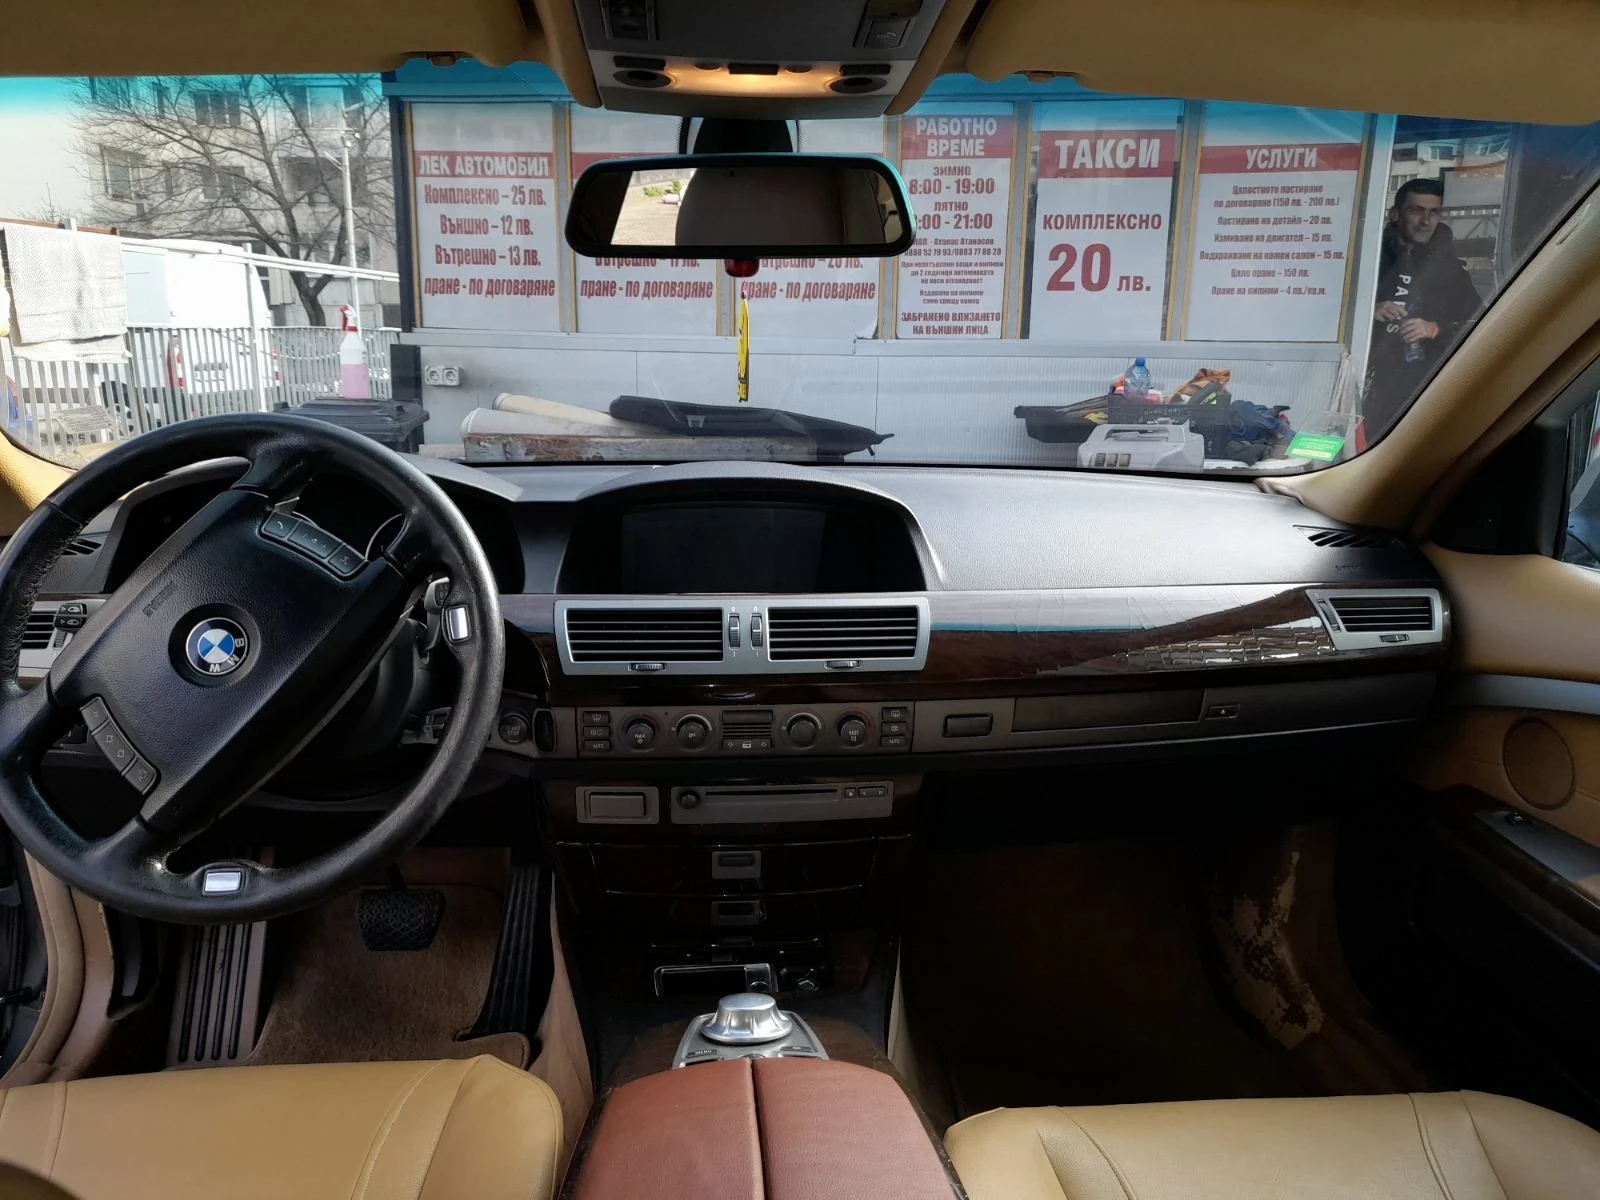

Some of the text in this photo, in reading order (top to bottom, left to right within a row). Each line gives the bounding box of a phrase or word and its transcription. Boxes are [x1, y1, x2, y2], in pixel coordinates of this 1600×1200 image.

[915, 117, 997, 136] РАБОТНО
[926, 138, 985, 157] ВРЕМЕ
[1054, 138, 1161, 170] ТАКСИ
[419, 155, 549, 177] ЛЕК АВТОМОБИЛ
[1245, 147, 1318, 170] УСЛУГИ
[933, 165, 971, 177] ЗИМНО
[424, 184, 499, 206] Комплексно
[511, 185, 526, 205] 25
[528, 188, 546, 206] лв.
[909, 178, 942, 195] 8:00
[954, 177, 995, 195] 19:00
[934, 201, 969, 212] ЛЯТНО
[440, 214, 489, 236] Външно
[501, 215, 513, 236] 12
[515, 219, 533, 236] лв.
[914, 213, 942, 230] :00
[953, 213, 993, 230] 21:00
[1042, 213, 1162, 231] КОМПЛЕКСНО
[435, 244, 497, 267] Вътрешно
[508, 245, 521, 266] 13
[523, 248, 541, 267] лв.
[1046, 242, 1151, 292] 20 лв.
[424, 278, 460, 297] пране
[469, 278, 484, 296] по
[485, 278, 555, 298] договаряне
[580, 280, 617, 298] пране
[625, 280, 640, 298] по
[641, 280, 713, 300] договаряне
[785, 281, 801, 299] по
[802, 281, 876, 302] договаряне
[901, 312, 1001, 322] ЗАБРАНЕНО ВЛИЗАНЕТО
[912, 325, 989, 335] НА ВЪНШНИ ЛИЦА
